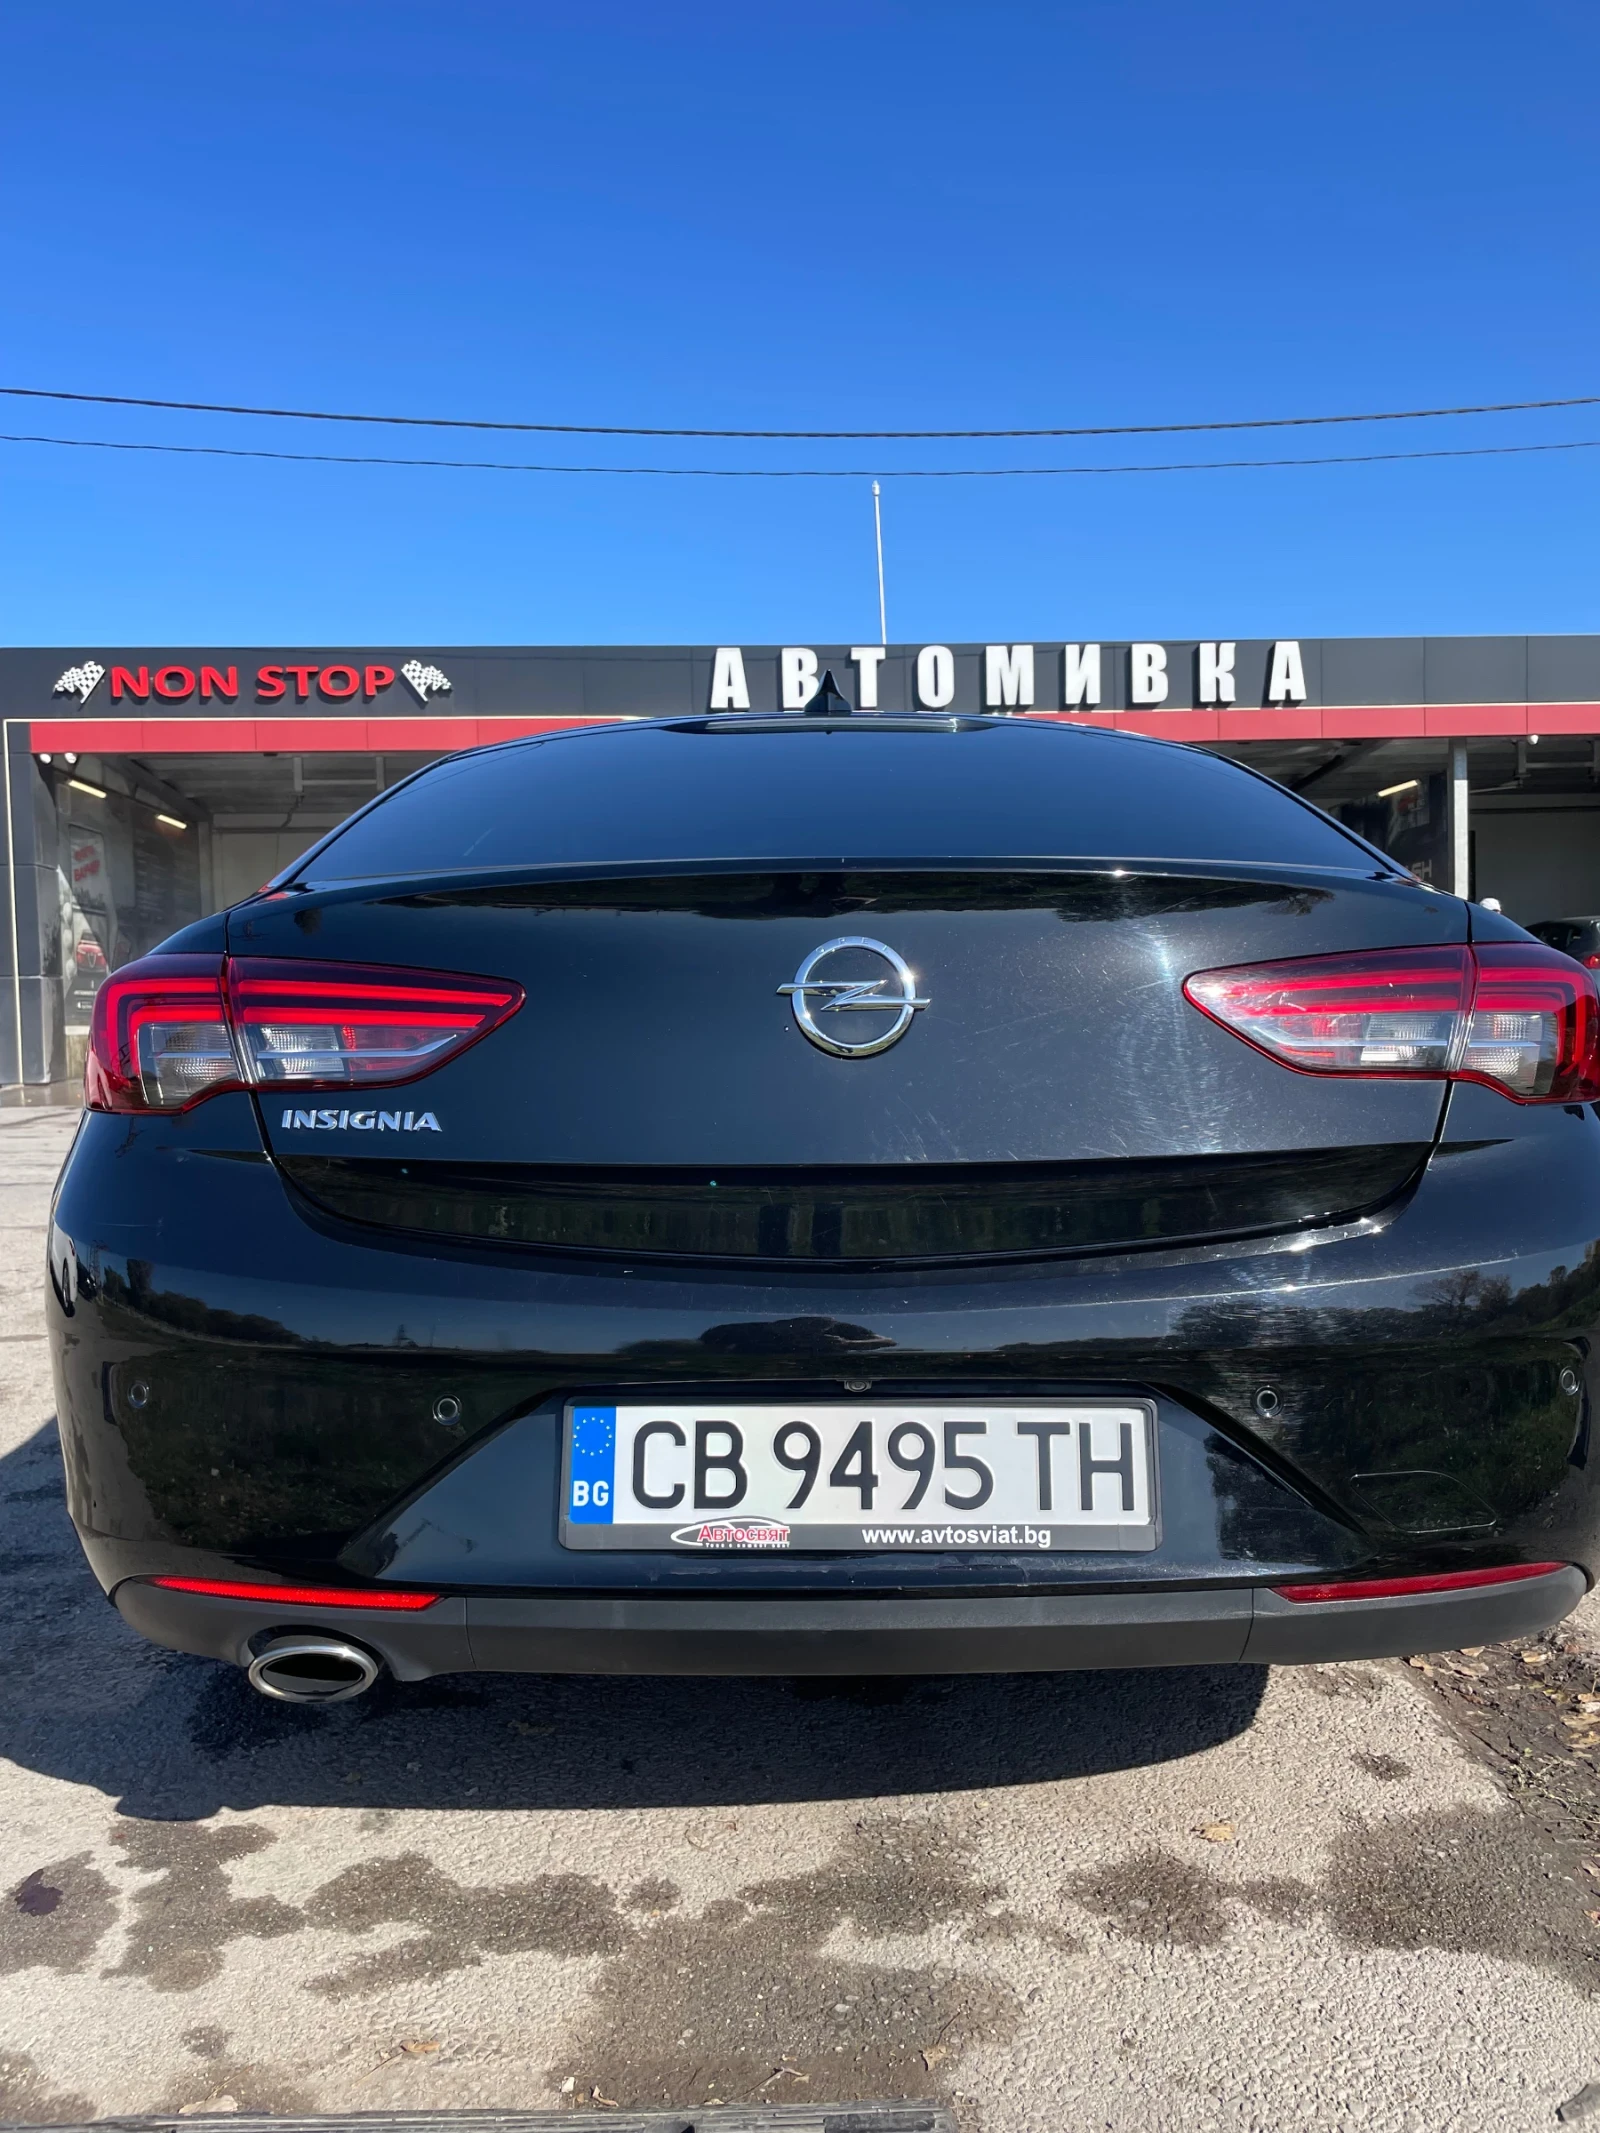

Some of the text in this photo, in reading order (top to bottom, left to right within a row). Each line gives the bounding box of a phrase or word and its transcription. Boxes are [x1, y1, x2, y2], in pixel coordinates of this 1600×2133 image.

[111, 665, 396, 698] NON STOP
[709, 640, 1308, 711] АВТОМИВКА
[281, 1109, 442, 1132] INSIGNIA
[632, 1420, 1135, 1512] CB 9495 TH
[572, 1480, 610, 1507] BG
[861, 1525, 1052, 1549] www.avtosviat.bg
